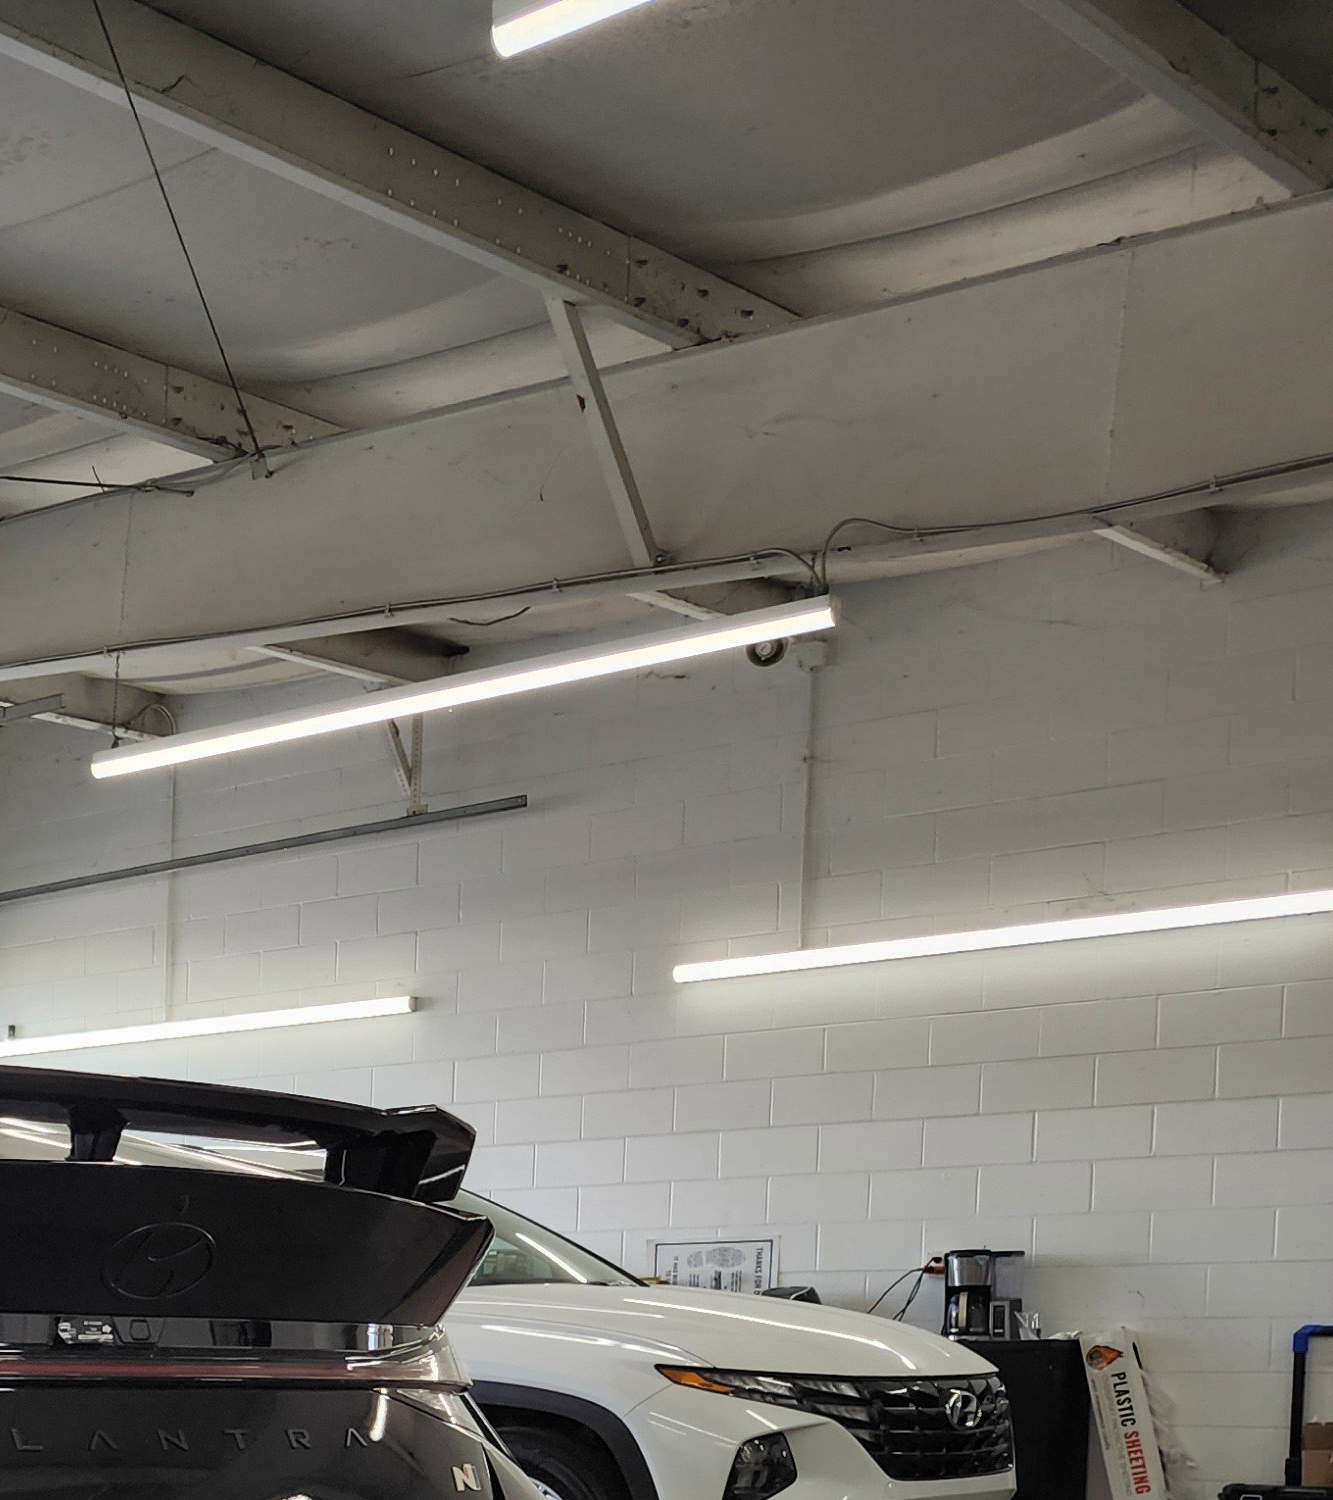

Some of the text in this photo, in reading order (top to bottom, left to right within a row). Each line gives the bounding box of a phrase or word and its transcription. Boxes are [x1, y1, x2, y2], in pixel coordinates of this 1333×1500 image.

[755, 1247, 763, 1273] THANKS
[754, 1275, 762, 1289] FOR
[1111, 1371, 1137, 1427] PLASTIC
[1123, 1430, 1151, 1495] SHEETING
[452, 1463, 482, 1493] N
